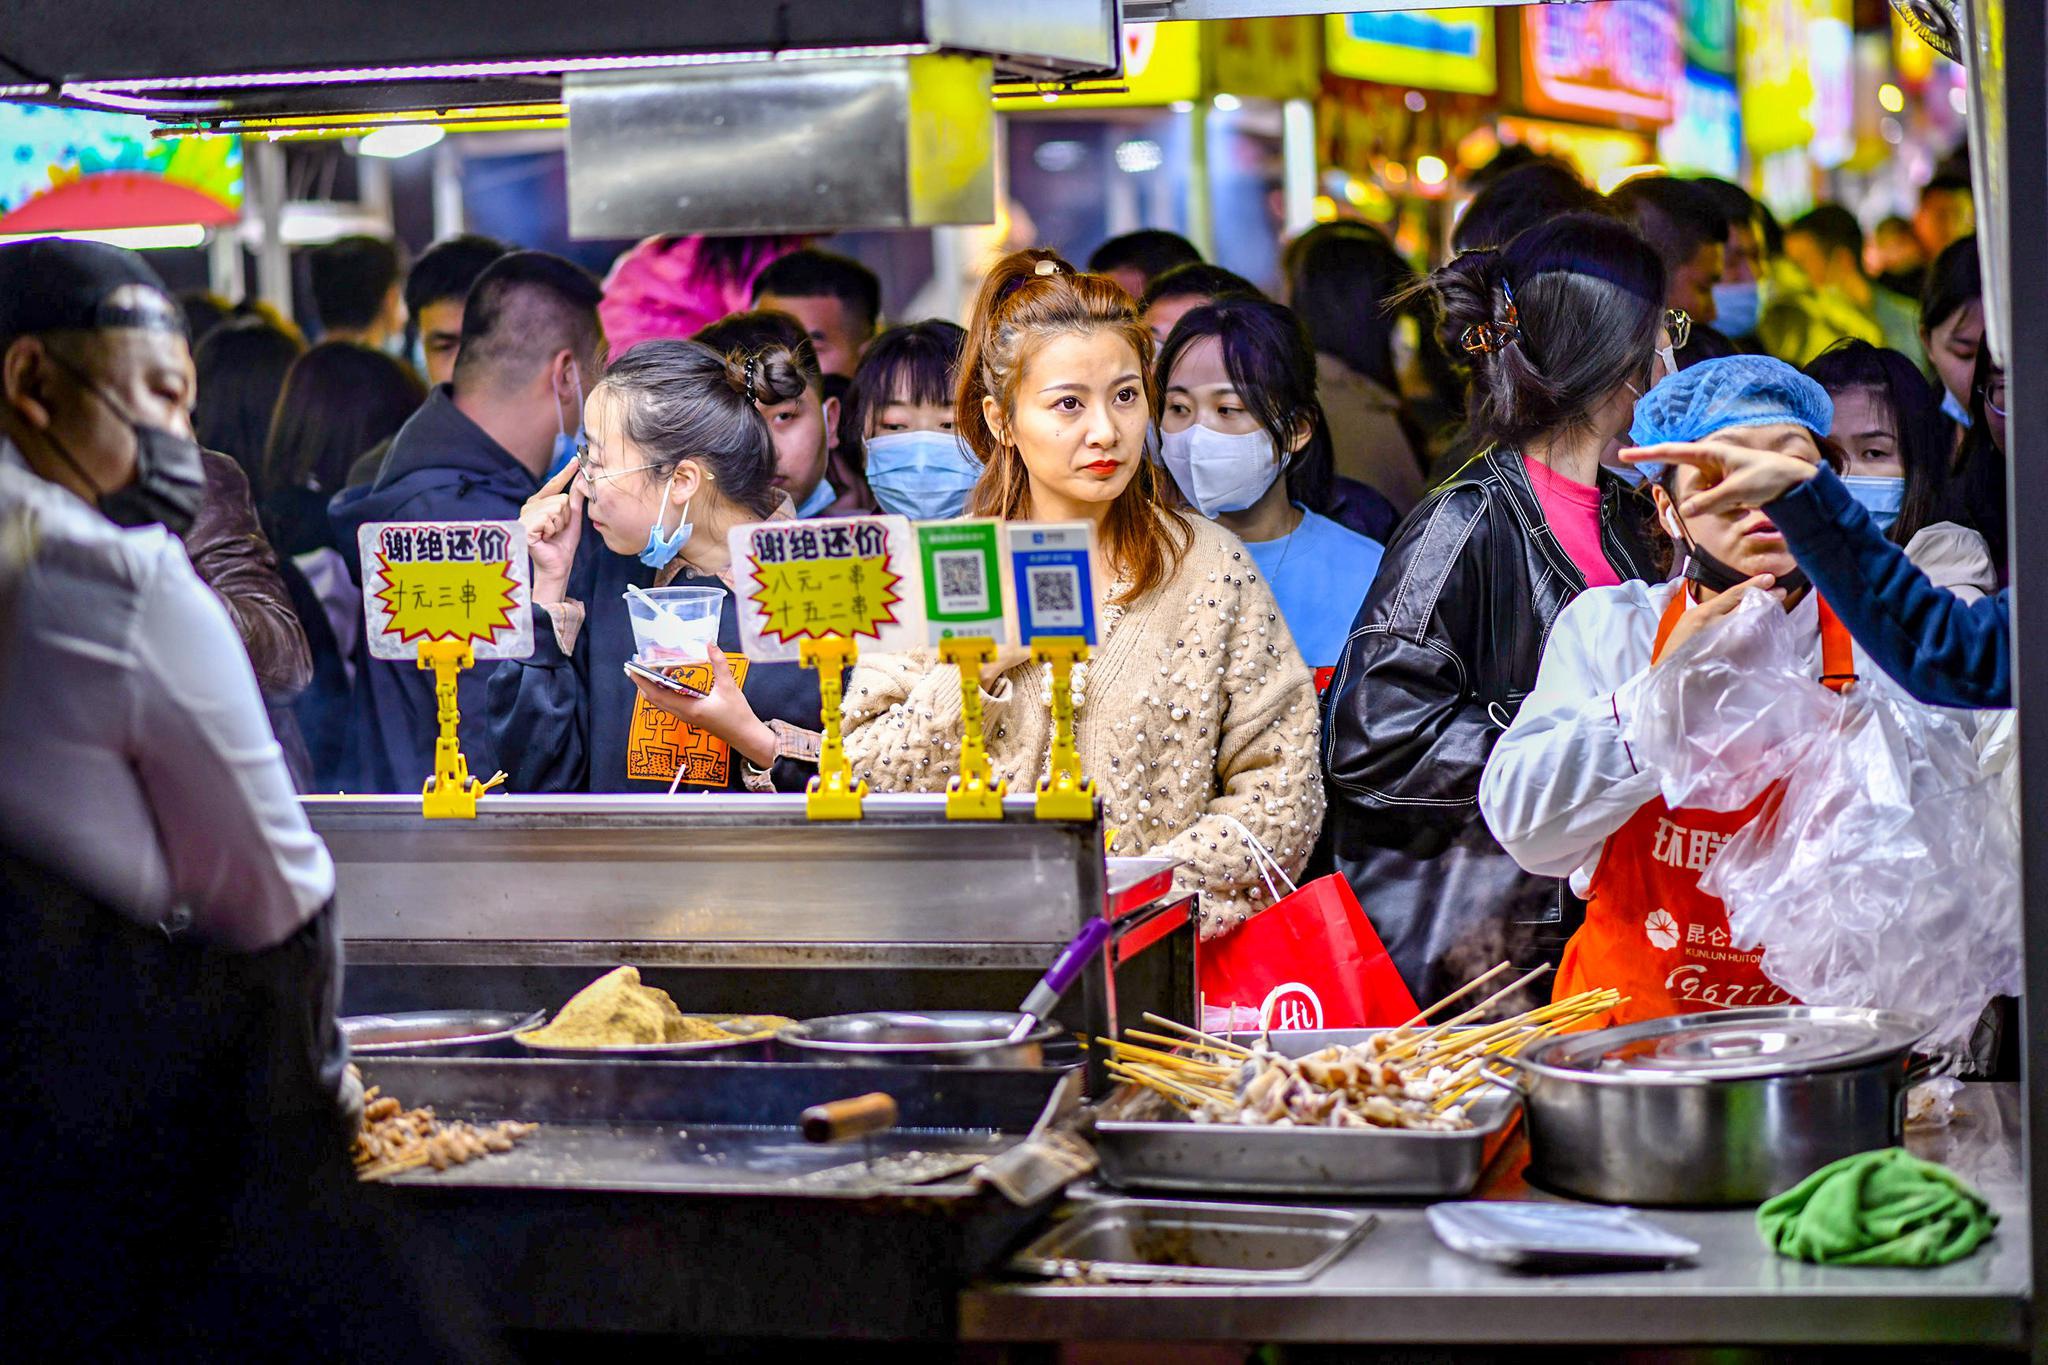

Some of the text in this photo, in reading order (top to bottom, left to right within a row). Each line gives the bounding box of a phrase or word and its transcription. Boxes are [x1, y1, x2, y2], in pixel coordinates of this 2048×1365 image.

[385, 529, 506, 562] 谢绝还价
[756, 525, 883, 562] 谢绝还价
[772, 564, 865, 595] 八元一串
[393, 579, 477, 619] 十元三串
[777, 595, 868, 627] 十五二串
[1685, 947, 1726, 961] KUNLUN
[1279, 1000, 1314, 1030] Hi
